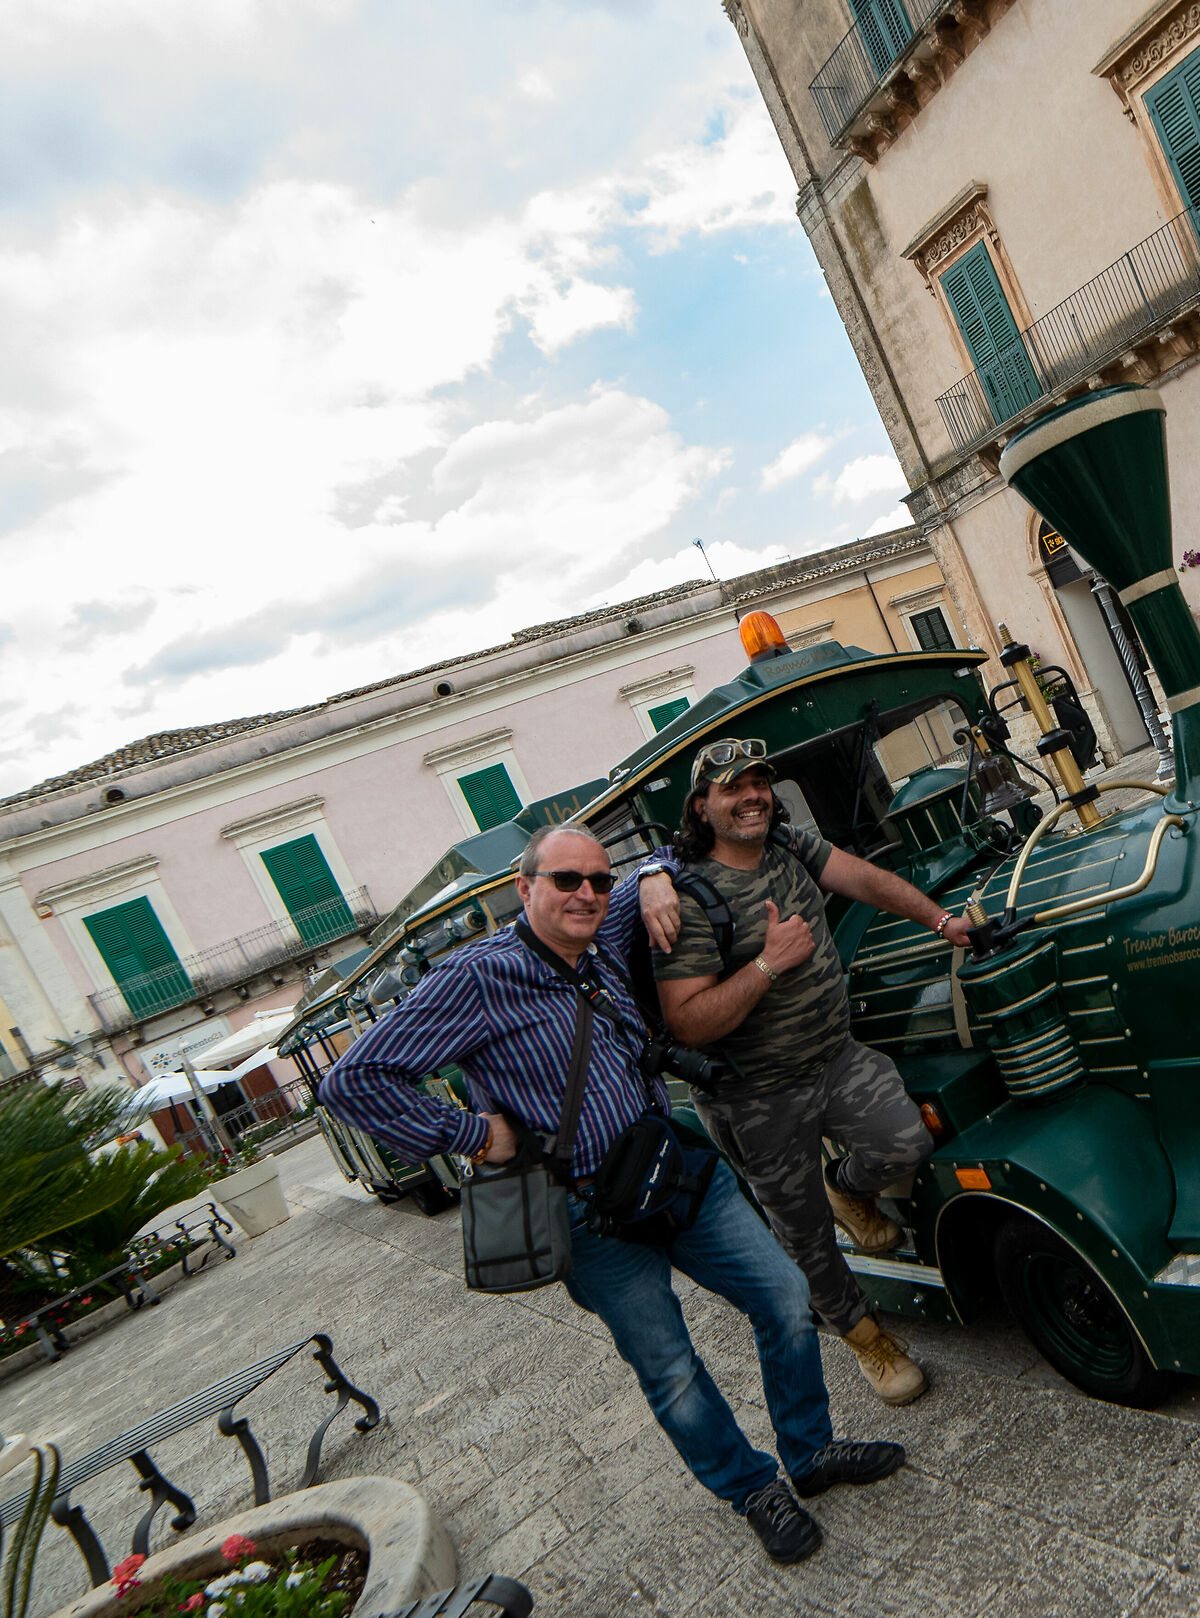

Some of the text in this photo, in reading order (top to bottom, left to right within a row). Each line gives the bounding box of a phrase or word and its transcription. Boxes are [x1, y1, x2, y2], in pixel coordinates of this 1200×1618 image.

[763, 656, 810, 677] Ragusa
[544, 795, 598, 825] Ibl
[1123, 929, 1166, 955] Trenino
